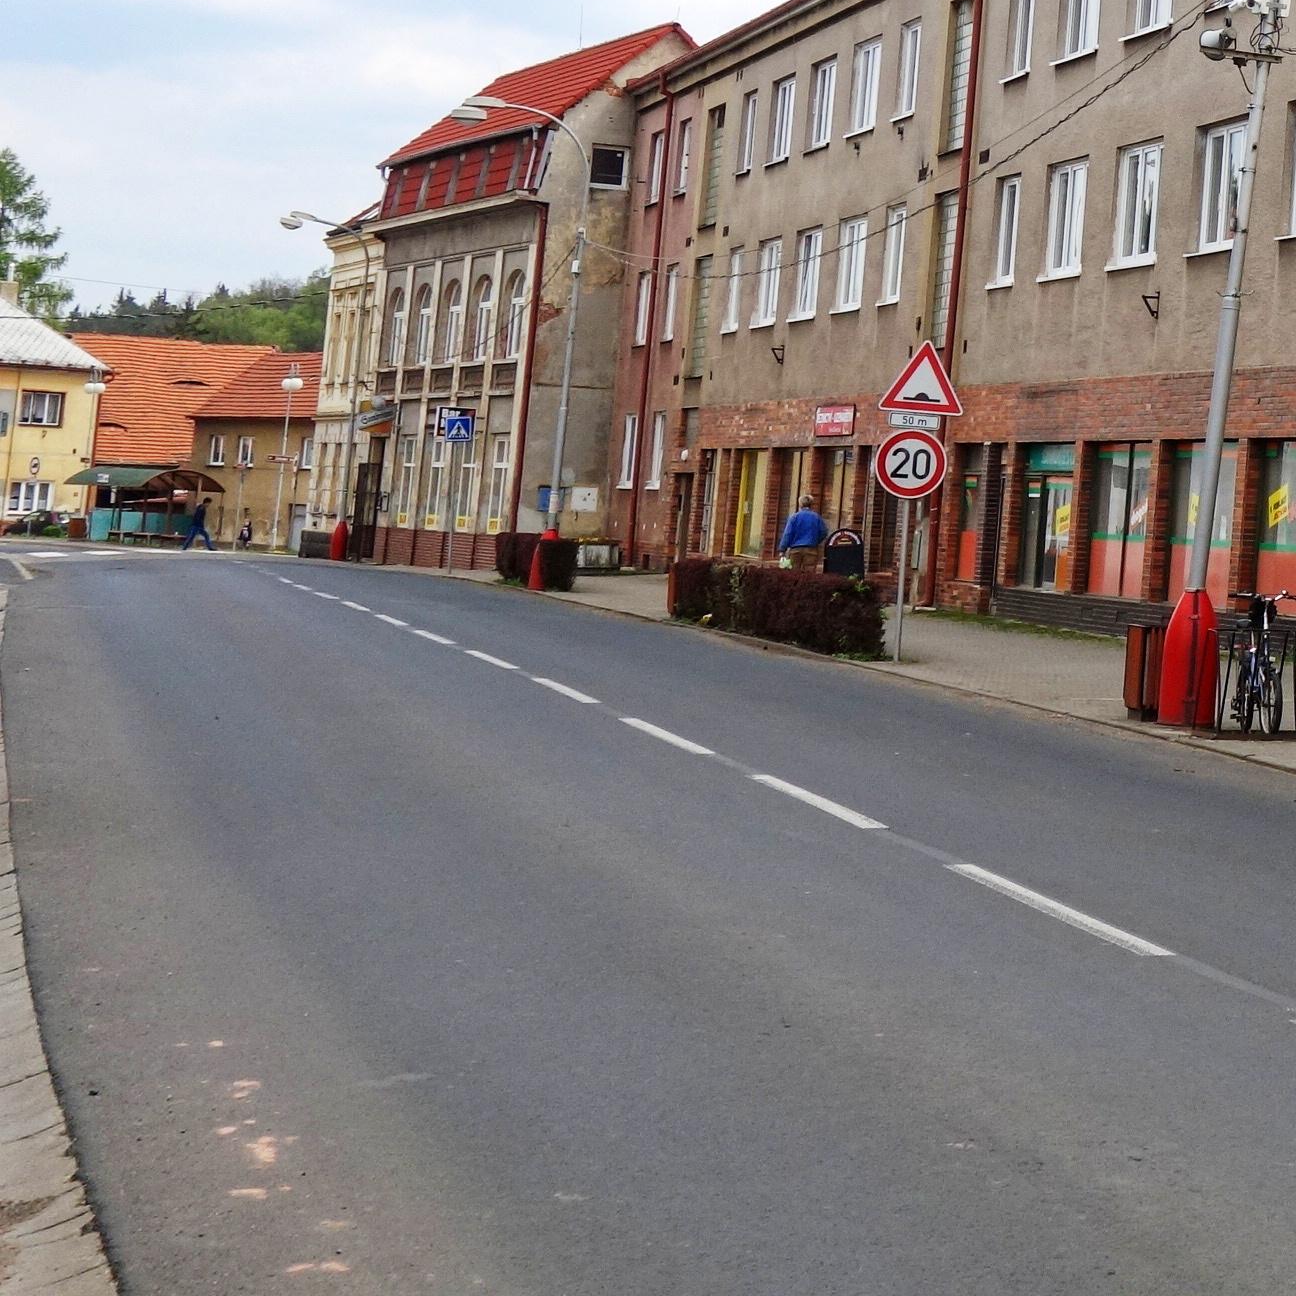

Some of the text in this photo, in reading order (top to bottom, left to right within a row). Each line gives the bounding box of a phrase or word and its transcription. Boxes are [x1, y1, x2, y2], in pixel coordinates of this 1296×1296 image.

[902, 415, 927, 426] 50 m
[890, 447, 931, 480] 20
